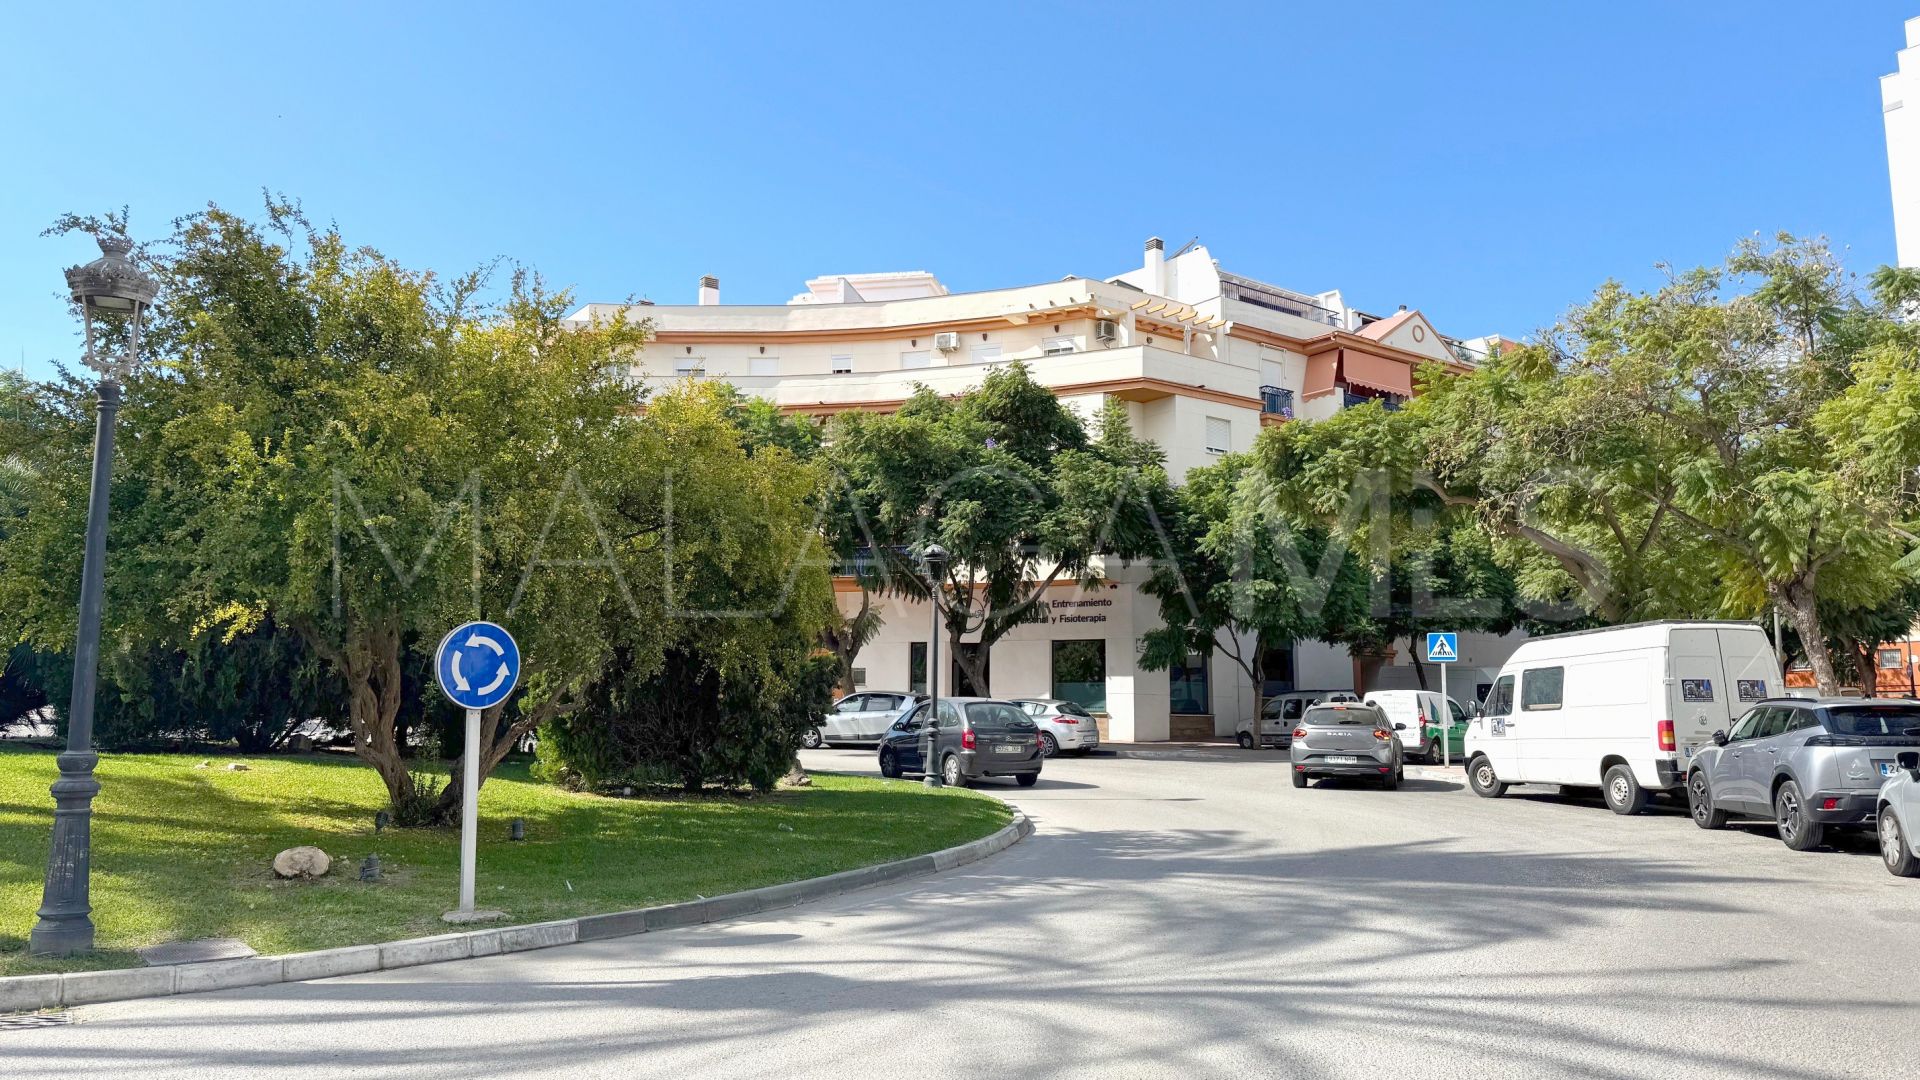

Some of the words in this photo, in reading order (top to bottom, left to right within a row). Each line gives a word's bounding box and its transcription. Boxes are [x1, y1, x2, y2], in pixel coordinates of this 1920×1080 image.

[1052, 598, 1112, 608] Entrenamiento
[1052, 616, 1056, 624] y
[1060, 613, 1106, 624] Fisioterapia
